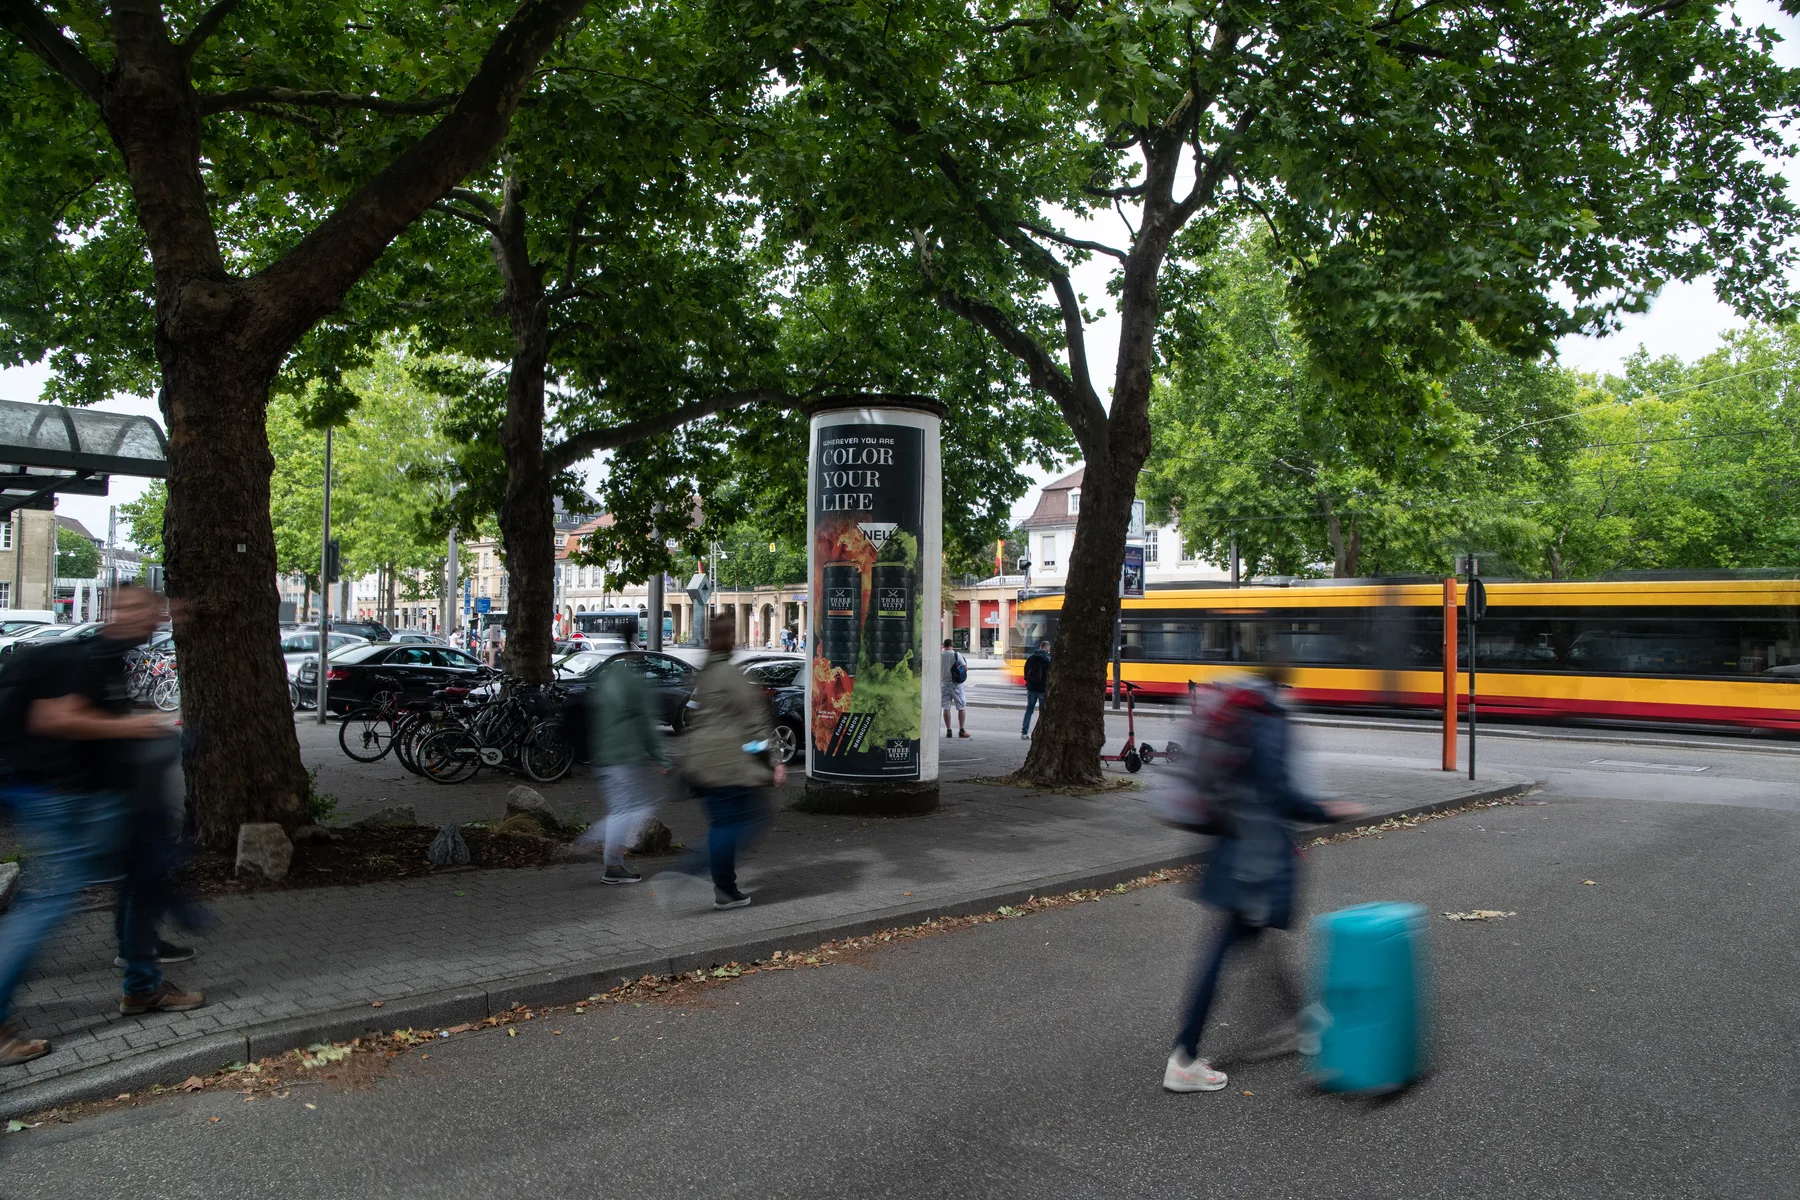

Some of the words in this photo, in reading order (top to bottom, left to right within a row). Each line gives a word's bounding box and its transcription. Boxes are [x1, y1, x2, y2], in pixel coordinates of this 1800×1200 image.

[823, 438, 859, 446] WHEREVER
[823, 448, 894, 466] COLOR
[822, 470, 880, 488] YOUR
[821, 493, 873, 512] LIFE
[863, 530, 893, 541] NEU
[847, 716, 859, 736] LEMON
[853, 716, 872, 750] MARACUJA
